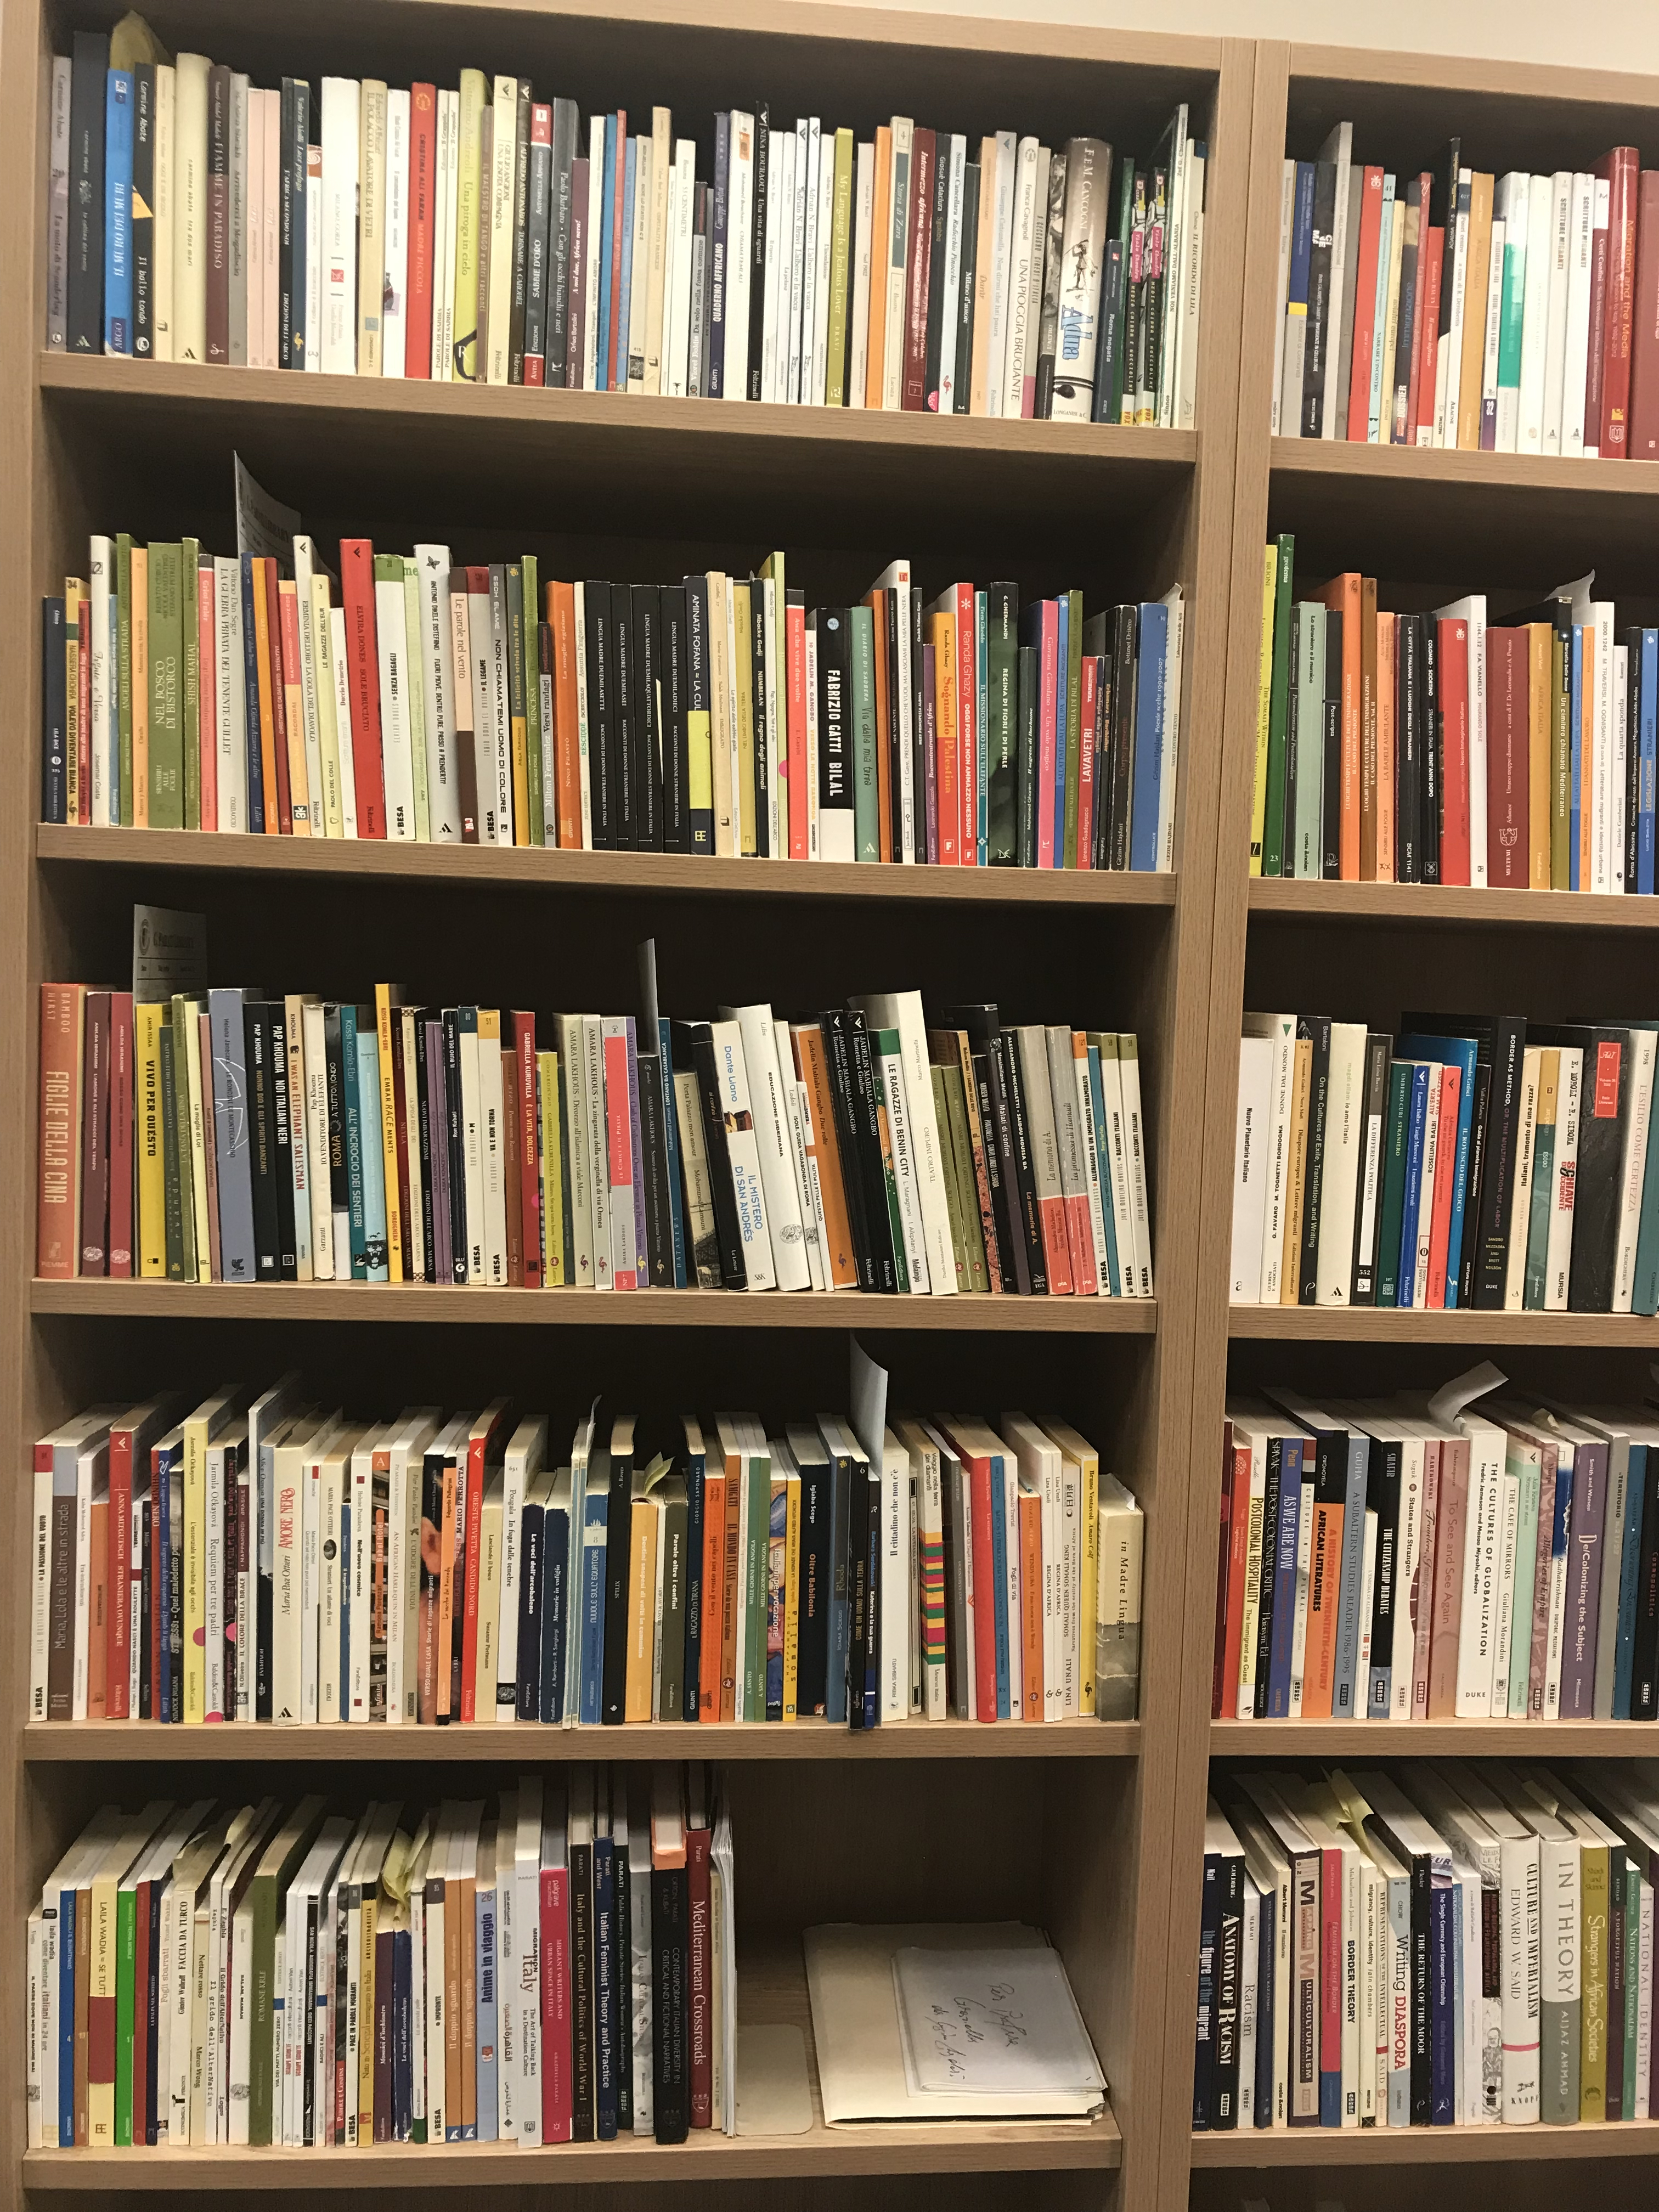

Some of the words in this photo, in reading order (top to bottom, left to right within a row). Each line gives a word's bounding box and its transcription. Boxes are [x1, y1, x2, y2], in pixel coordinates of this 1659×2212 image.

[139, 80, 149, 115] Carmine
[138, 116, 148, 142] Abate
[463, 181, 473, 202] Una
[837, 174, 848, 189] My
[459, 204, 470, 237] piroga
[835, 191, 848, 235] Language
[461, 239, 470, 250] in
[837, 237, 846, 245] Is
[137, 256, 147, 266] Il
[461, 252, 471, 276] cielo
[713, 242, 724, 282] AFFRICANO
[835, 255, 845, 286] Jealous
[1017, 258, 1029, 283] UNA
[137, 269, 147, 295] ballo
[964, 270, 972, 296] Milano
[138, 299, 147, 324] tondo
[712, 283, 723, 322] QUADERNO
[834, 289, 844, 314] Lover
[962, 296, 971, 324] d'autore
[1014, 285, 1027, 334] PIOGGIA
[1622, 301, 1631, 320] the
[1057, 304, 1094, 363] Adua
[1621, 323, 1630, 358] Media
[1010, 336, 1024, 401] BRUCIANTE
[751, 369, 759, 400] Feltrinelli
[154, 660, 165, 699] BOSCO
[165, 656, 176, 713] BISTORCO
[495, 663, 504, 726] CHIAMATEMI
[827, 669, 842, 720] FABRIZIO
[154, 703, 165, 724] NEL
[940, 675, 955, 735] Sognando
[1560, 697, 1567, 707] Un
[165, 717, 176, 729] DI
[828, 724, 842, 753] GATTI
[498, 759, 505, 769] DI
[944, 740, 955, 793] Palestina
[1081, 727, 1093, 782] LAVAVETRI
[828, 761, 843, 797] BILAL
[272, 1025, 283, 1040] PAP
[273, 1041, 285, 1073] KHOUMA
[724, 1045, 734, 1074] Dante
[887, 1063, 896, 1073] LE
[145, 1059, 155, 1087] VIVO
[274, 1079, 286, 1093] NOI
[1318, 1076, 1326, 1087] On
[46, 1070, 70, 1118] FIGLIE
[146, 1090, 156, 1111] PER
[727, 1075, 737, 1102] Liano
[889, 1075, 902, 1115] RAGAZZE
[275, 1094, 287, 1125] ITALIANI
[768, 1071, 778, 1118] EDUCAZIONE
[774, 1119, 783, 1158] SIBERIANA
[894, 1116, 903, 1126] DI
[998, 1104, 1008, 1124] Malati
[1245, 1107, 1253, 1126] Nuovo
[1316, 1102, 1324, 1132] Cultures
[44, 1121, 69, 1168] DELLA
[276, 1126, 288, 1144] NERI
[895, 1128, 907, 1155] BENIN
[1002, 1133, 1011, 1157] confine
[1243, 1127, 1252, 1159] Planetario
[1315, 1133, 1322, 1142] of
[899, 1157, 910, 1177] CITY
[1313, 1142, 1322, 1162] Exile,
[1242, 1159, 1250, 1183] Italiano
[1310, 1163, 1321, 1205] Translation,
[44, 1171, 68, 1203] CINA
[1307, 1221, 1317, 1248] Writing
[1489, 1462, 1498, 1482] THE
[1249, 1497, 1264, 1555] POSTCOLONIAL
[1486, 1487, 1497, 1541] CULTURES
[530, 1533, 537, 1543] Le
[1316, 1509, 1327, 1551] AFRICAN
[1383, 1527, 1393, 1541] THE
[207, 1537, 219, 1577] Requiem
[1120, 1541, 1129, 1552] in
[1485, 1547, 1493, 1560] OF
[808, 1553, 816, 1576] Oltre
[1119, 1556, 1128, 1594] Madre
[1381, 1542, 1392, 1584] CITIZENSHIP
[207, 1579, 217, 1595] per
[528, 1560, 537, 1615] dell'arcobaleno
[1246, 1554, 1261, 1604] HOSPITALITY
[1312, 1553, 1324, 1612] LITERATURES
[808, 1577, 816, 1617] Babilonia
[1379, 1585, 1390, 1615] DEBATES
[1479, 1566, 1492, 1656] GLOBALIZATION
[207, 1612, 220, 1636] padri
[1115, 1598, 1128, 1640] Lingua
[1526, 1863, 1538, 1915] CULTURE
[1558, 1861, 1574, 1888] IN
[599, 1911, 610, 1942] Italian
[1510, 1888, 1521, 1945] EDWARD
[1526, 1917, 1538, 1935] AND
[481, 1912, 495, 1953] viaggio
[692, 1900, 706, 1990] Mediterranean
[1201, 1929, 1216, 1945] the
[1222, 1912, 1240, 1983] ANATOMY
[1557, 1898, 1574, 1995] THEORY
[197, 1954, 205, 1979] Nettare
[481, 1955, 493, 1967] in
[600, 1944, 610, 1987] Feminist
[1198, 1945, 1215, 1975] figure
[1347, 1939, 1355, 1982] BORDER
[1392, 1933, 1408, 1991] Writing
[481, 1969, 493, 2003] Anime
[1199, 1976, 1213, 1987] of
[1510, 1971, 1521, 1999] SAID
[1527, 1938, 1538, 2018] IMPERIALISM
[599, 1989, 610, 2024] Theory
[1199, 1988, 1212, 2002] the
[1222, 1985, 1234, 2004] OF
[1347, 1983, 1355, 2023] THEORY
[601, 2027, 611, 2045] and
[693, 1994, 707, 2065] Crossroads
[1194, 2005, 1212, 2042] migrant
[1217, 2007, 1236, 2064] RACISM
[1394, 1995, 1406, 2070] DIASPORA
[601, 2047, 611, 2088] Practice
